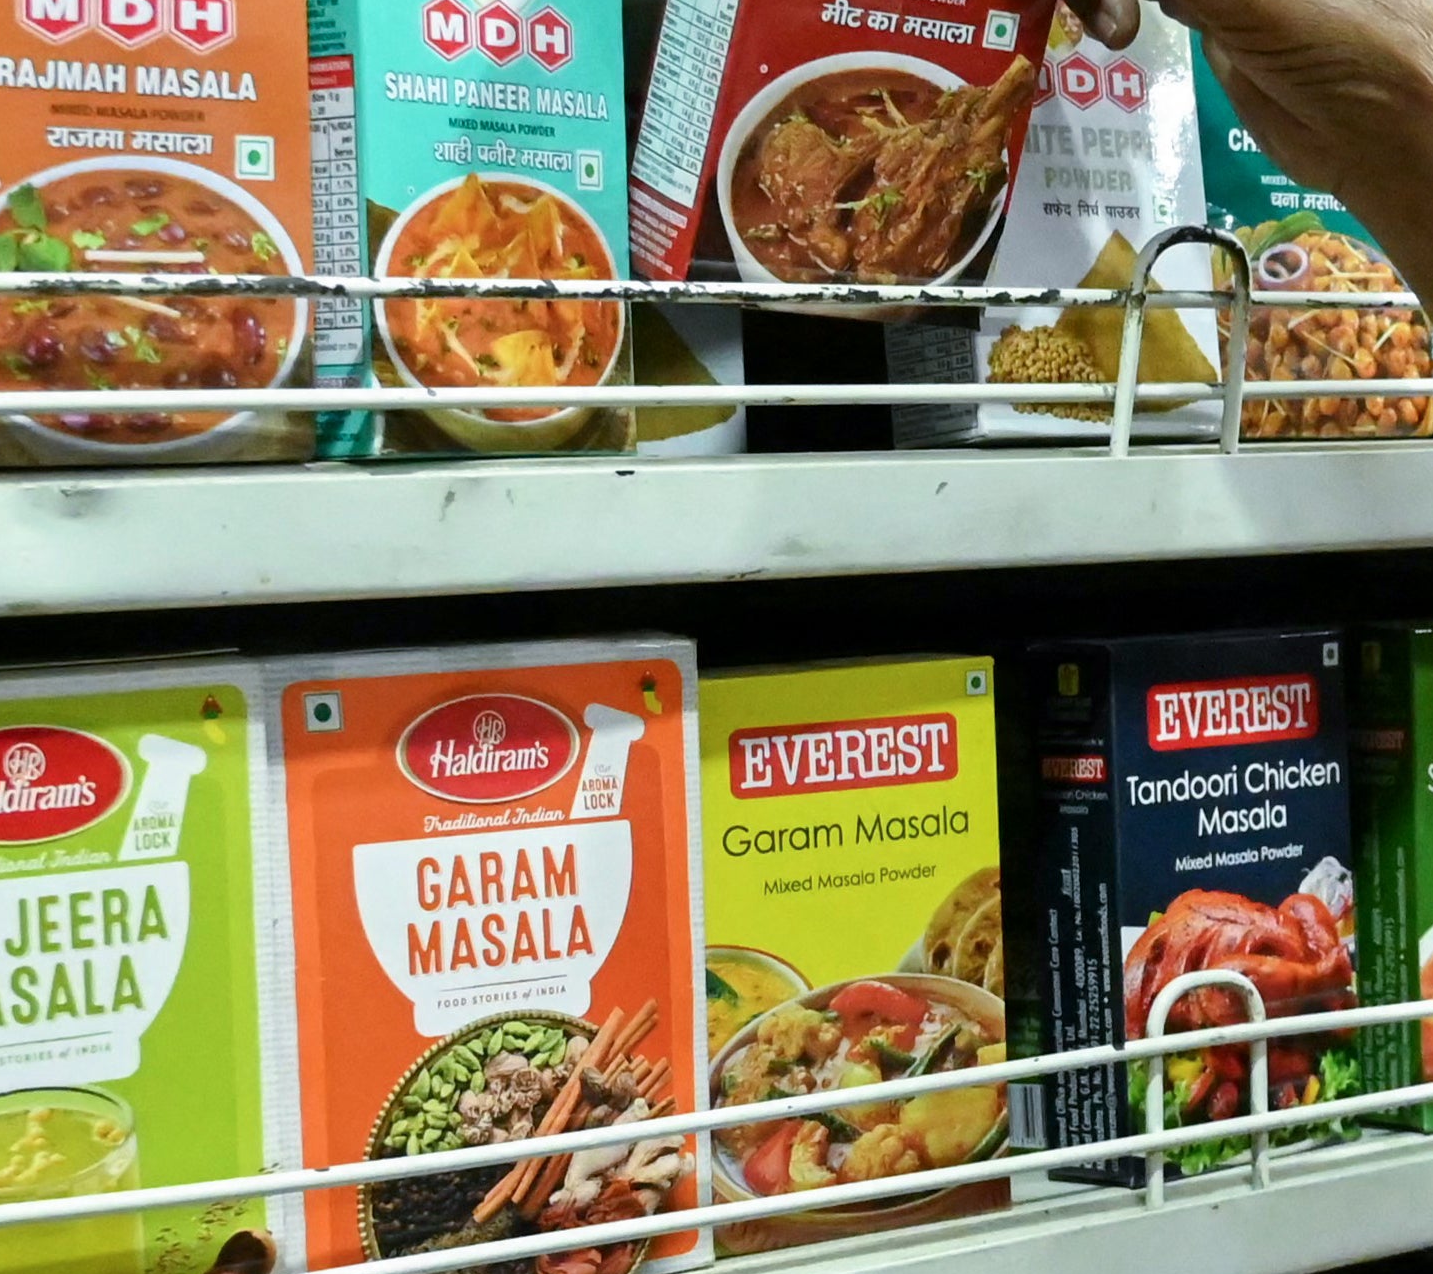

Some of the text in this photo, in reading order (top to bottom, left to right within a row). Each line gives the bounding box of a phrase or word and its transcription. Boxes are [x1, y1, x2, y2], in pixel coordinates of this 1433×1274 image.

[868, 10, 901, 35] का
[902, 16, 976, 45] मसाला
[135, 65, 257, 101] MASALA
[384, 71, 610, 121] SHAHI PANEER MASALA
[477, 141, 518, 167] पनीर
[520, 150, 573, 173] मसाला
[1154, 681, 1312, 742] EVEREST
[429, 739, 550, 780] Haldiram's
[738, 722, 949, 790] EVEREST
[581, 776, 619, 794] AROMA
[1126, 758, 1341, 806] Tandoori Chicken
[583, 792, 616, 810] LOCK
[1196, 799, 1288, 838] Masala
[424, 807, 565, 834] Traditional Indian
[721, 805, 970, 858] Garam Masala
[48, 848, 112, 871] Indian
[134, 831, 172, 853] LOCK
[1174, 842, 1304, 873] Mixed Masala Powder
[416, 842, 579, 913] GARAM
[763, 862, 938, 897] Mixed Masala Powder
[5, 884, 171, 958] JEERA
[406, 904, 595, 978] MASALA
[436, 996, 469, 1010] FOOD
[472, 991, 519, 1006] STORIES
[536, 984, 567, 997] INDIA
